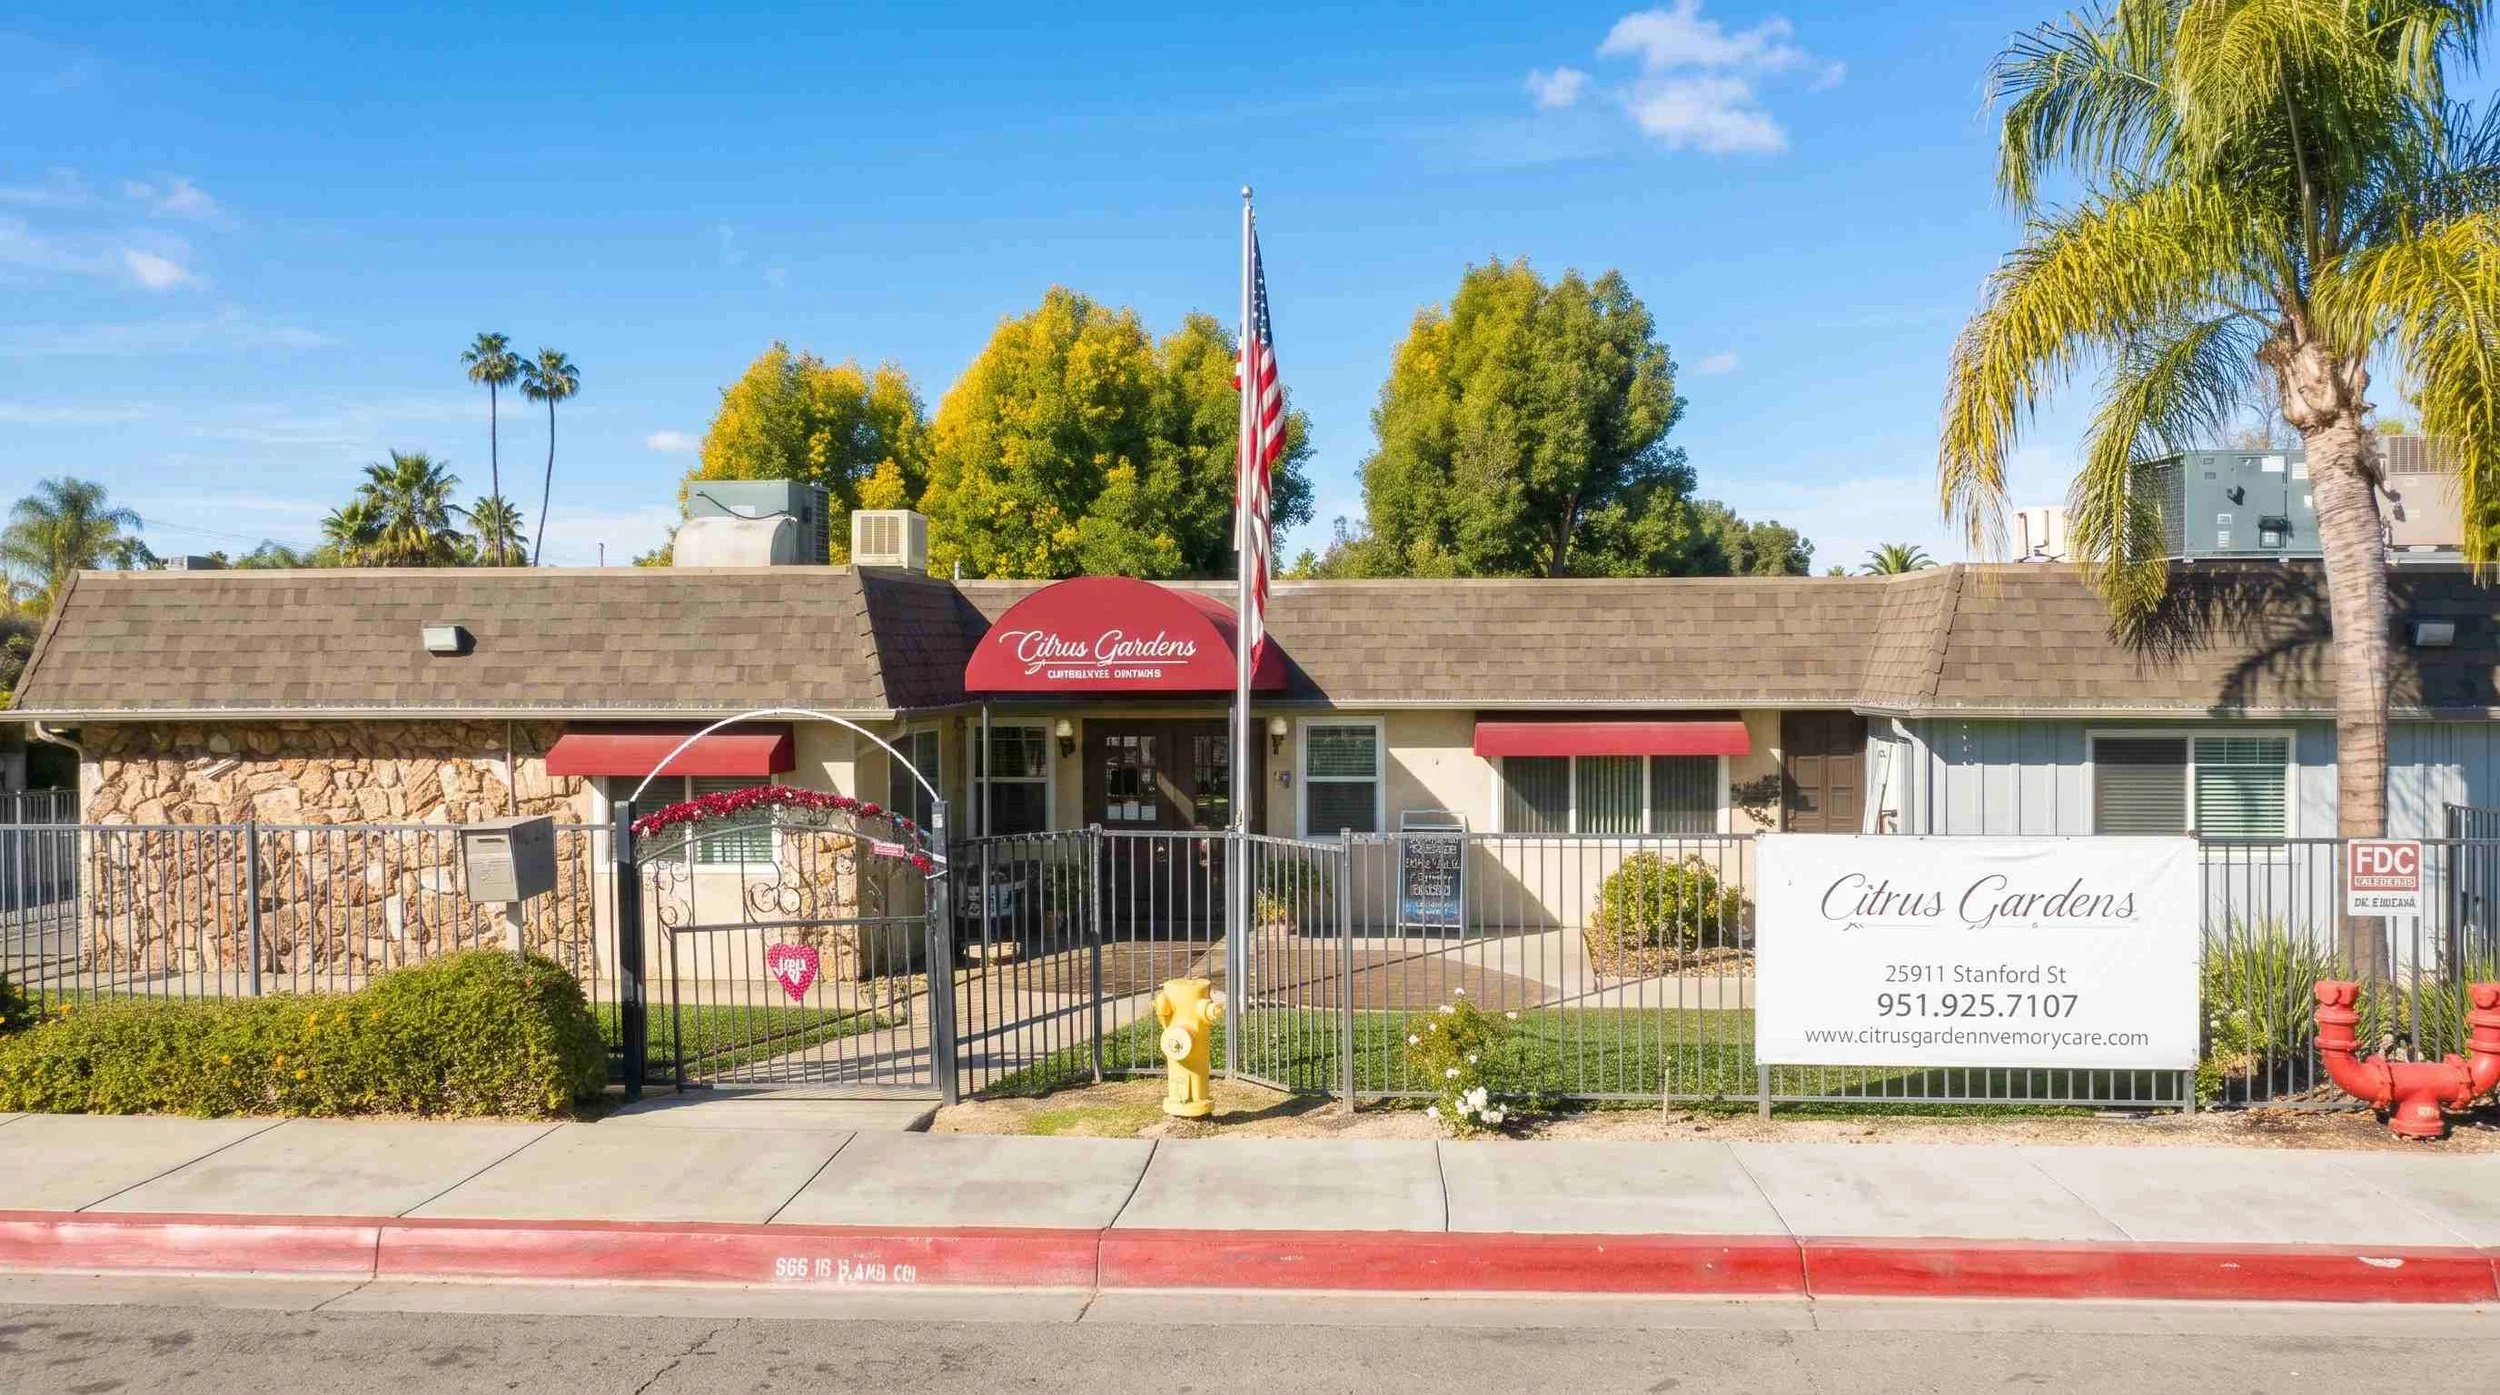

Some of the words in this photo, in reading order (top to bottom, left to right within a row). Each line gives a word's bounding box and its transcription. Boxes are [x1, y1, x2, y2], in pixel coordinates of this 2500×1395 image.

[1000, 630, 1088, 669] Citrus
[1094, 630, 1197, 667] Gardens
[2356, 846, 2415, 874] FDC
[1821, 873, 1944, 923] Citrus
[1959, 873, 2138, 929] Gardens
[1885, 964, 1944, 983] 25911
[1953, 964, 2040, 984] Stanford
[2047, 965, 2067, 984] St
[1877, 993, 2079, 1018] 951.925.7107
